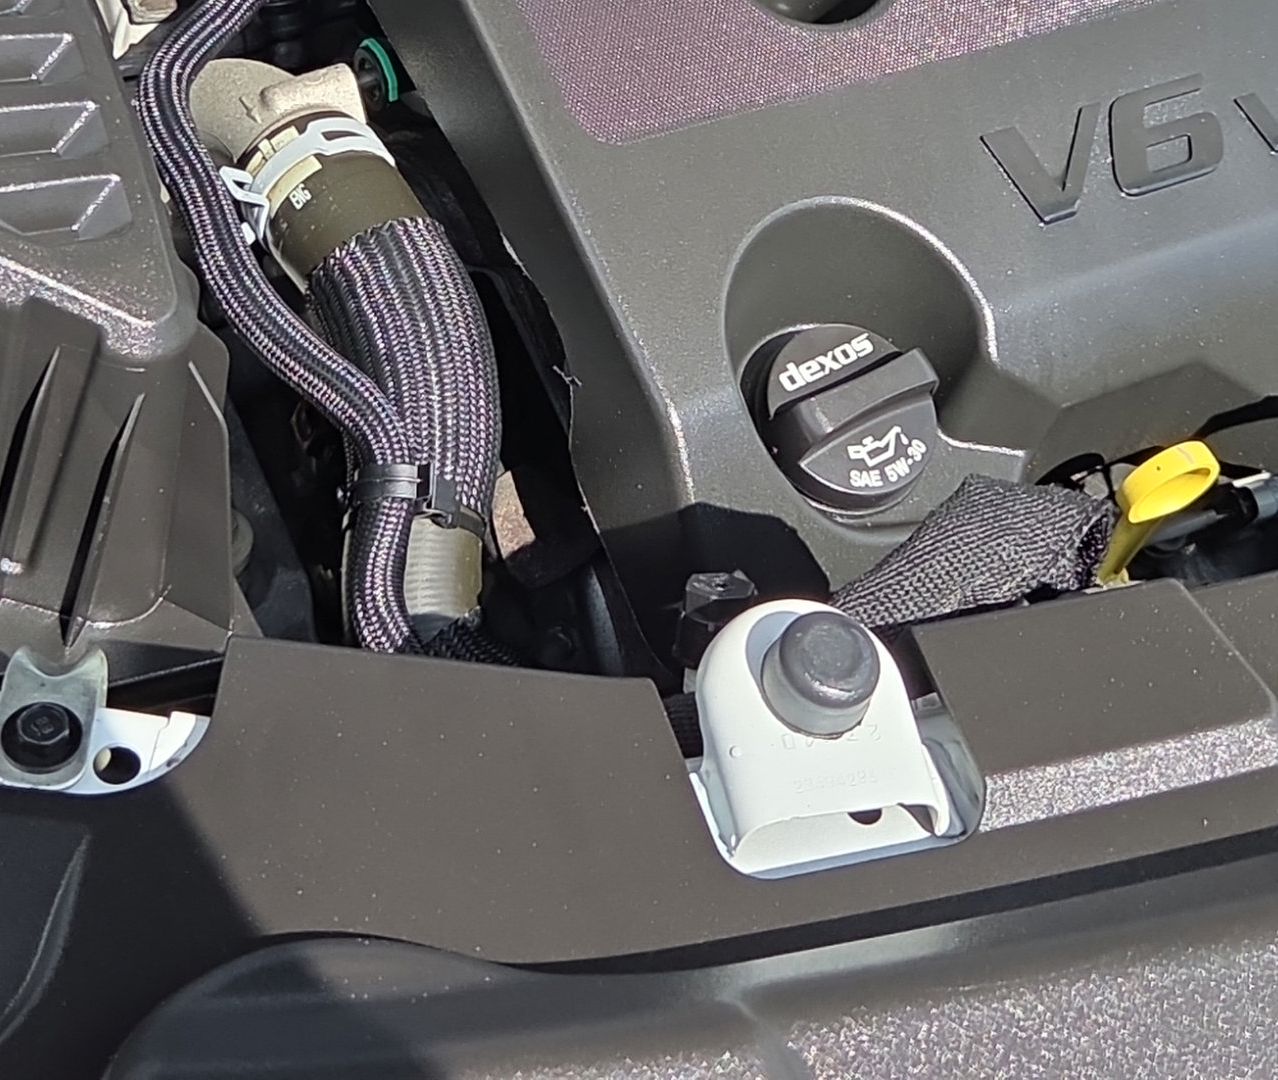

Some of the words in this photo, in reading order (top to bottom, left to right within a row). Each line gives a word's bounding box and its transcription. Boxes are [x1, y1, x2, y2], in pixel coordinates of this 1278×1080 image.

[980, 72, 1226, 226] V6
[779, 332, 874, 392] dexos
[849, 469, 884, 488] SAE
[884, 439, 928, 484] 5W-30
